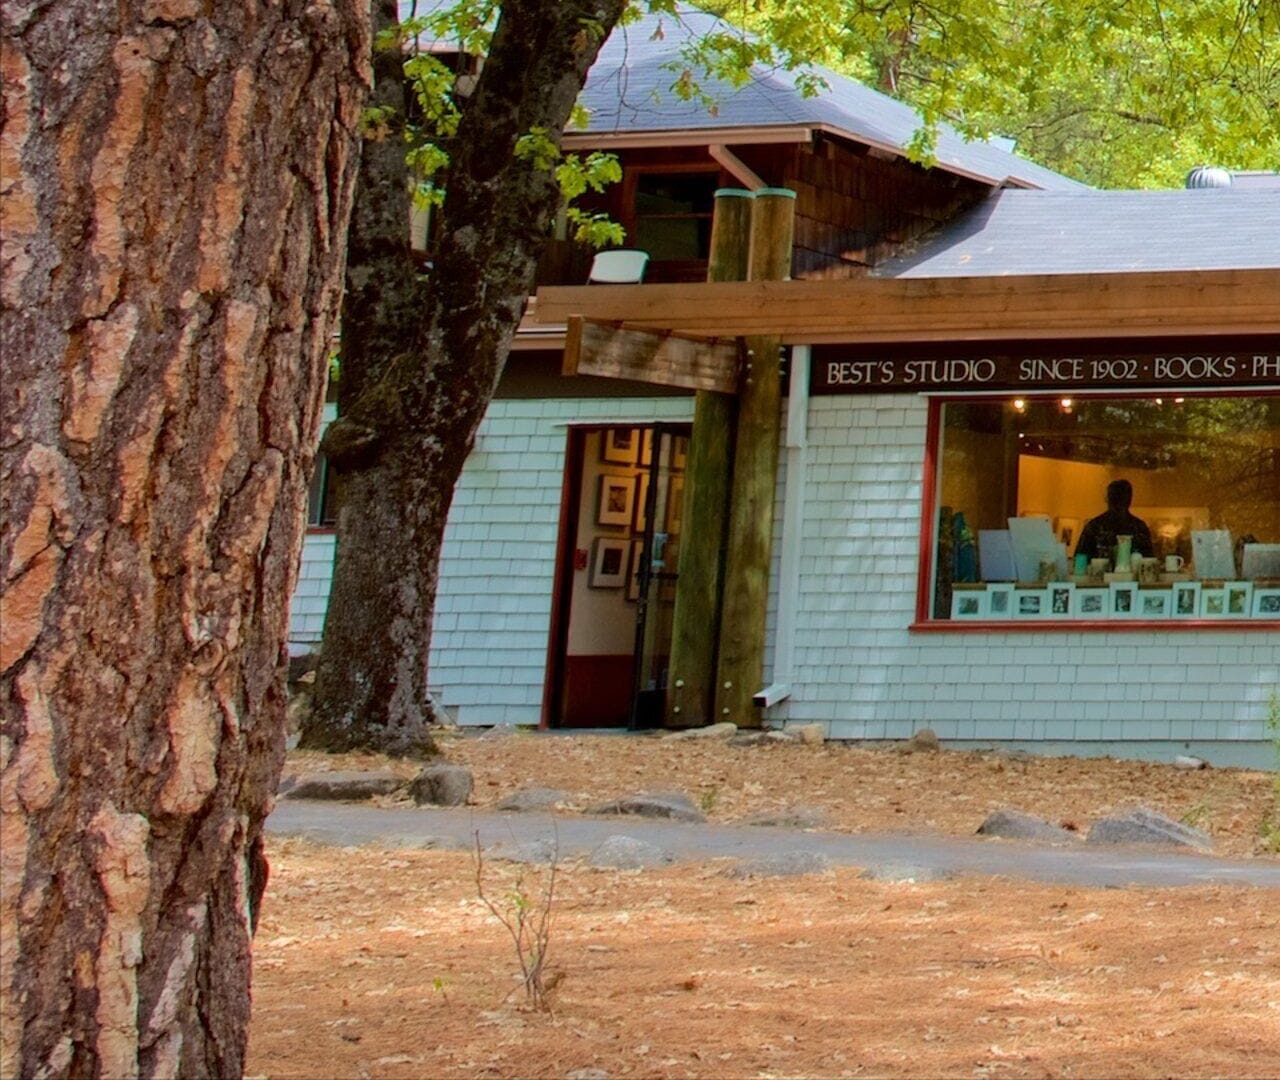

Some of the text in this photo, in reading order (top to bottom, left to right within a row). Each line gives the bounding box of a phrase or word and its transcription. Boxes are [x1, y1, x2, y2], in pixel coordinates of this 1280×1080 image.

[827, 361, 894, 384] BEST'S
[904, 358, 996, 383] STUDIO
[1019, 358, 1084, 380] SINCE
[1091, 360, 1138, 379] 1902
[1154, 356, 1236, 378] BOOKS
